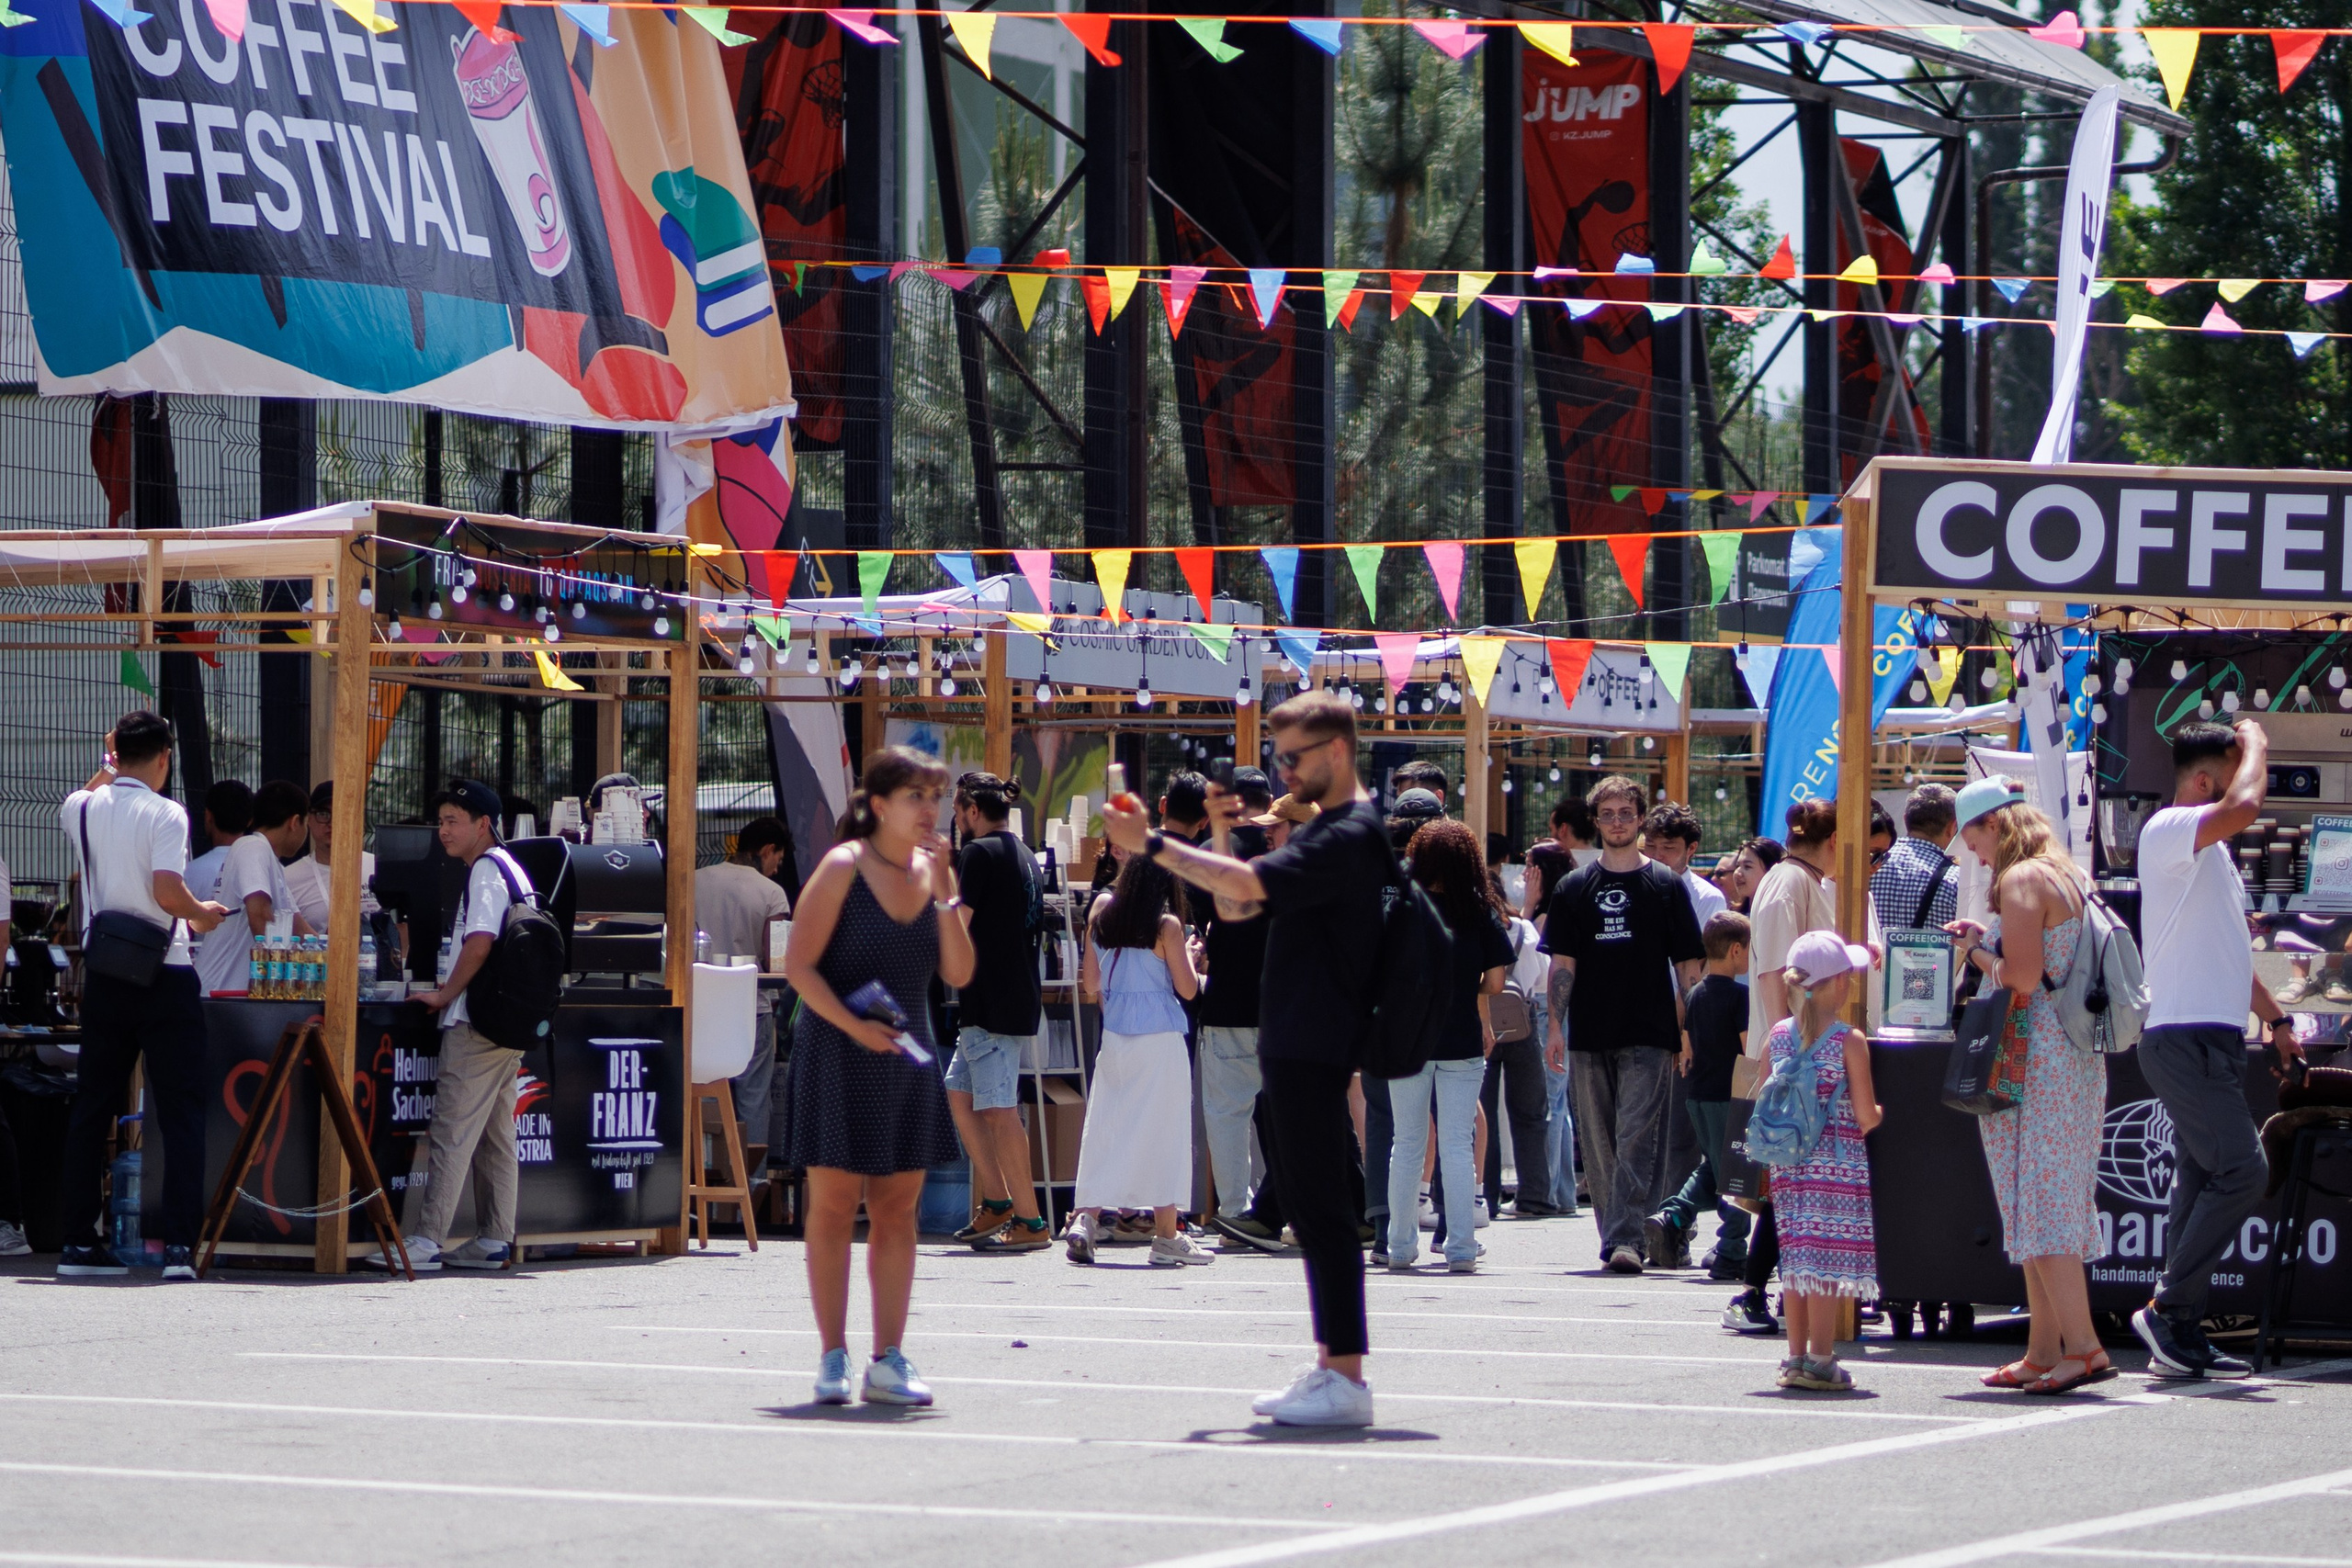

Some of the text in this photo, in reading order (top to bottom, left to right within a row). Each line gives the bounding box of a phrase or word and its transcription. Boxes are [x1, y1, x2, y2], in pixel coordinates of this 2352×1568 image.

[122, 0, 418, 114] COFFEE
[137, 97, 492, 258] FESTIVAL
[1916, 480, 2352, 592] COFFE
[539, 566, 554, 597] TO
[559, 568, 634, 605] QAZAQSAN
[1069, 618, 1123, 651] COSMIC
[1126, 626, 1181, 657] GARDEN
[1588, 672, 1641, 701] OFFEE
[1889, 933, 1952, 944] COFFEE!ONE
[394, 1048, 438, 1082] Helmu
[609, 1050, 649, 1089] DER-
[514, 1112, 551, 1136] ADE IN
[593, 1091, 657, 1137] FRANZ
[409, 1171, 424, 1187] 1929
[614, 1172, 633, 1189] WIEN
[2092, 1265, 2163, 1283] handmade
